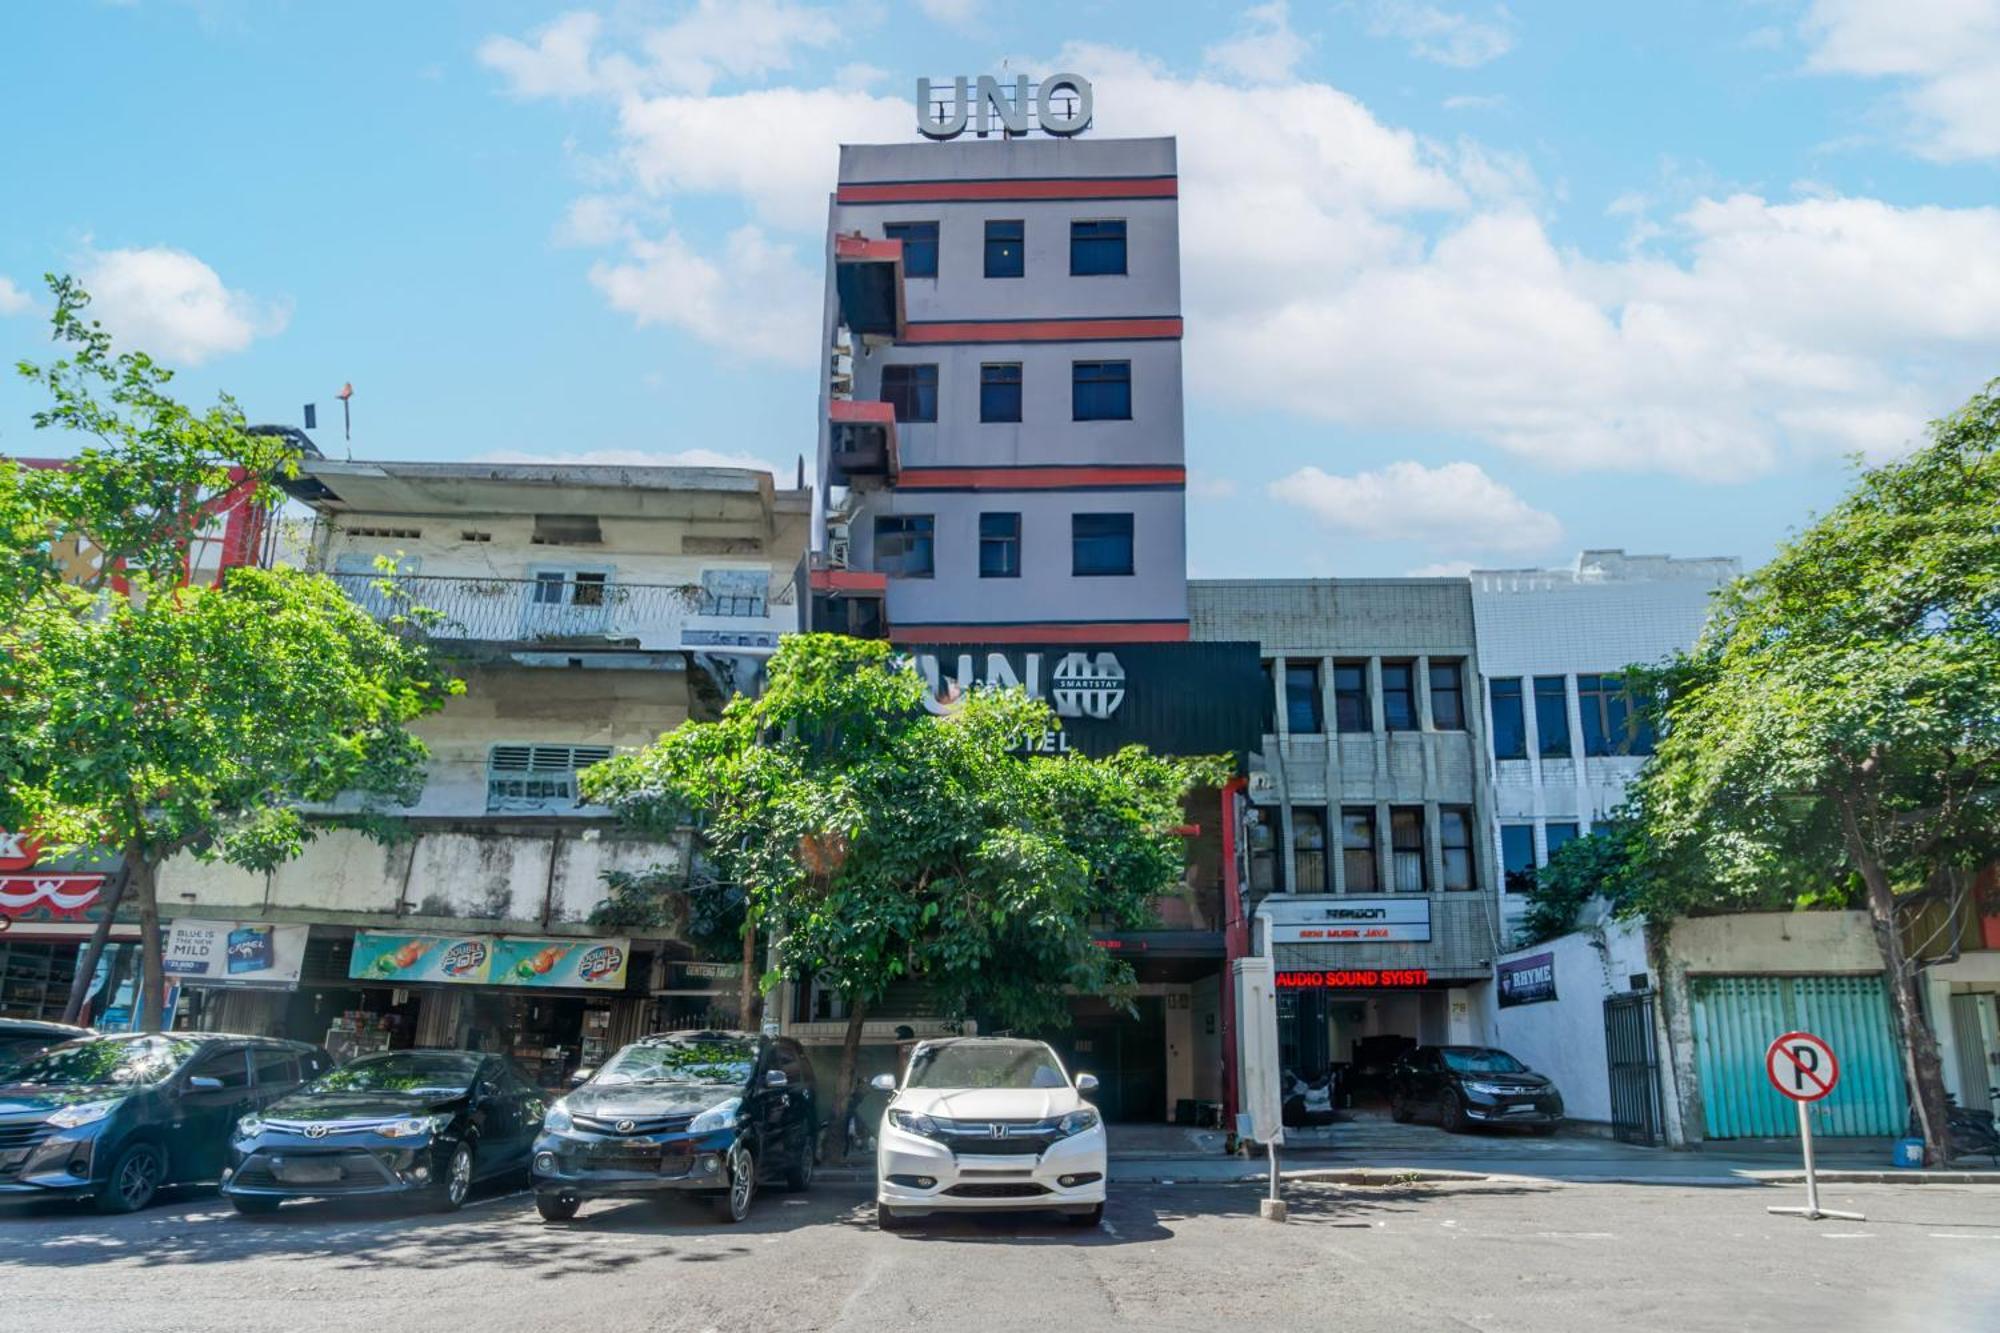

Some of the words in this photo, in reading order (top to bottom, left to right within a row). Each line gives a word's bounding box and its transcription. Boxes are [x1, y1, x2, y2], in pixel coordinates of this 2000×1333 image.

[917, 73, 1093, 141] UNO
[1059, 680, 1119, 688] SMARTSTAY
[177, 929, 201, 938] BLUE
[205, 930, 215, 939] IS
[174, 945, 209, 956] MILD
[228, 940, 265, 955] CAMEL
[448, 943, 482, 957] DOUBLE
[583, 948, 619, 962] DOUBLE
[442, 952, 484, 969] POP
[580, 956, 620, 973] POP
[1276, 972, 1323, 987] AUDIO
[1325, 971, 1378, 986] SOUND
[1513, 965, 1552, 987] RHYME
[1791, 1046, 1818, 1090] P
